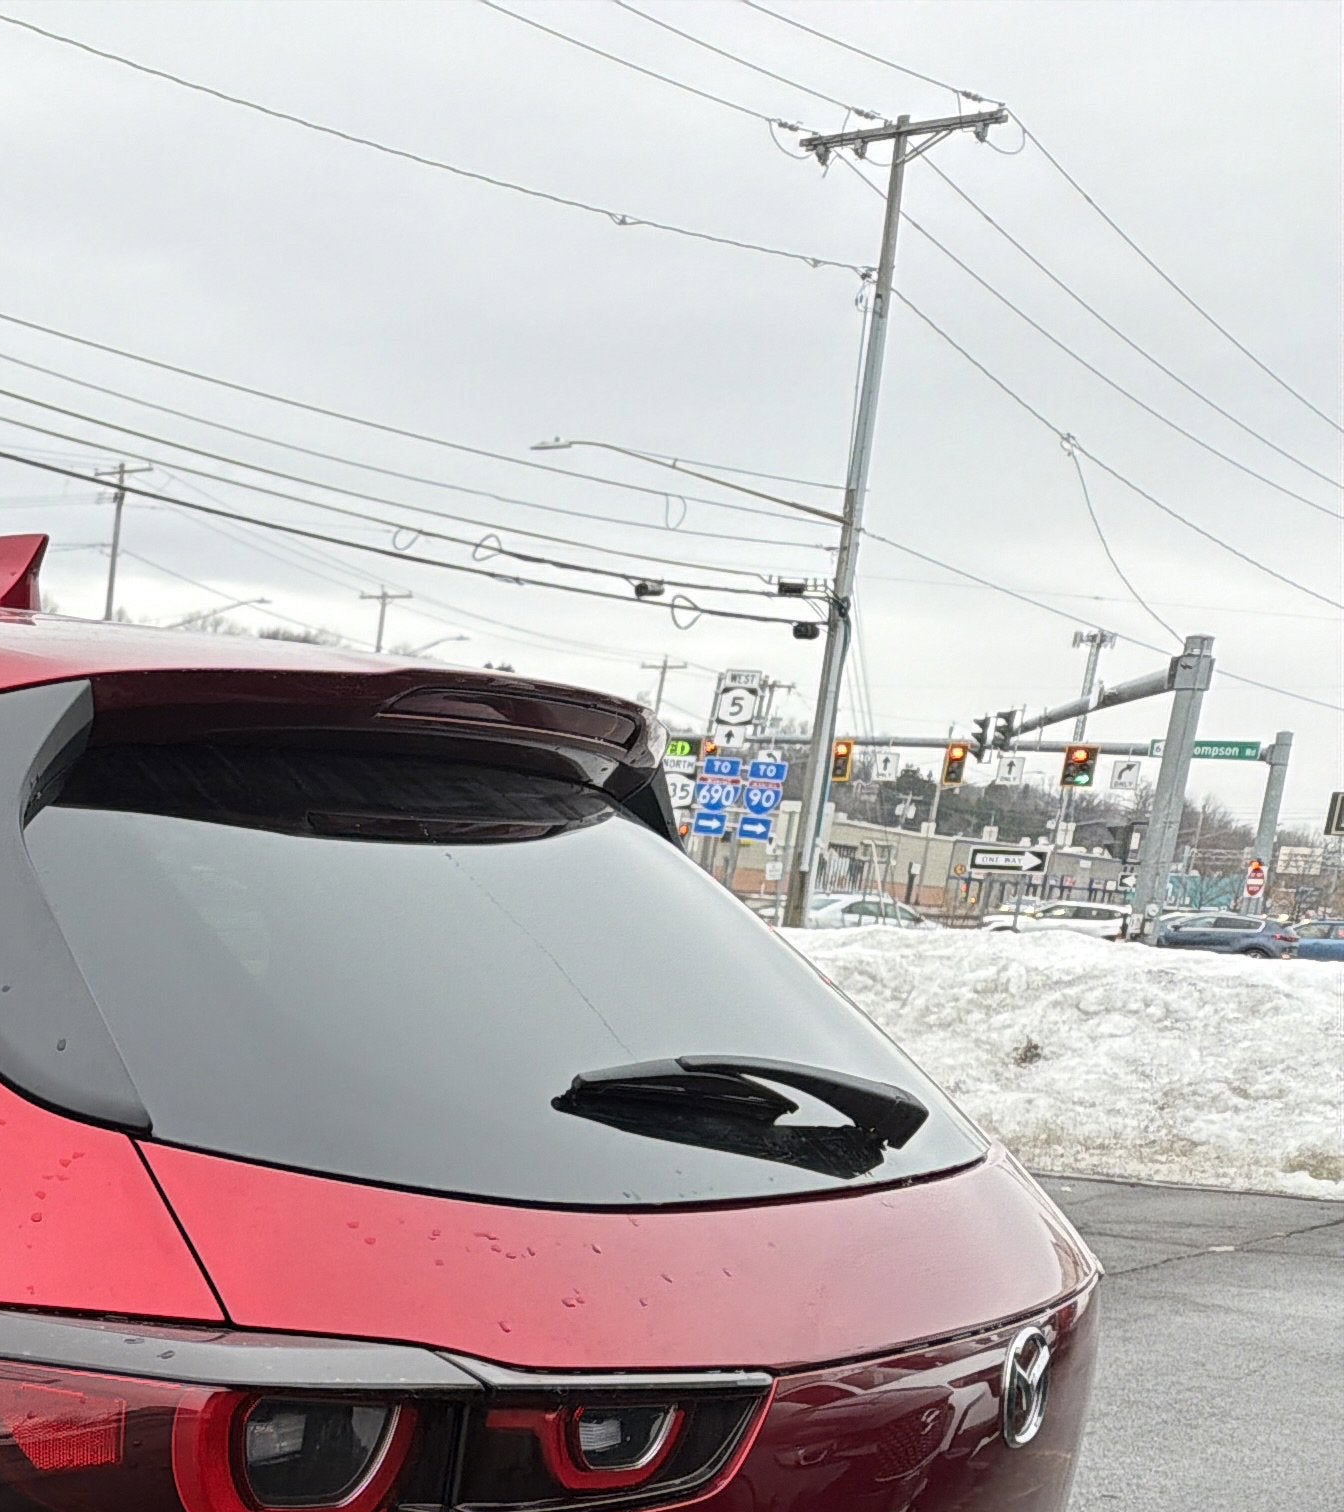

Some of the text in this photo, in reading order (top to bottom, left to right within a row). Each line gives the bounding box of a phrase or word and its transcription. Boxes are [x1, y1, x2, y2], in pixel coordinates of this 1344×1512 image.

[730, 674, 756, 684] WEST
[728, 696, 745, 717] 5
[1194, 746, 1239, 758] ompson
[663, 758, 695, 769] NORTH
[714, 762, 731, 773] TO
[759, 766, 777, 777] TO
[670, 782, 691, 801] 35
[698, 784, 735, 803] 690
[748, 789, 776, 808] 90
[981, 855, 999, 864] ONE
